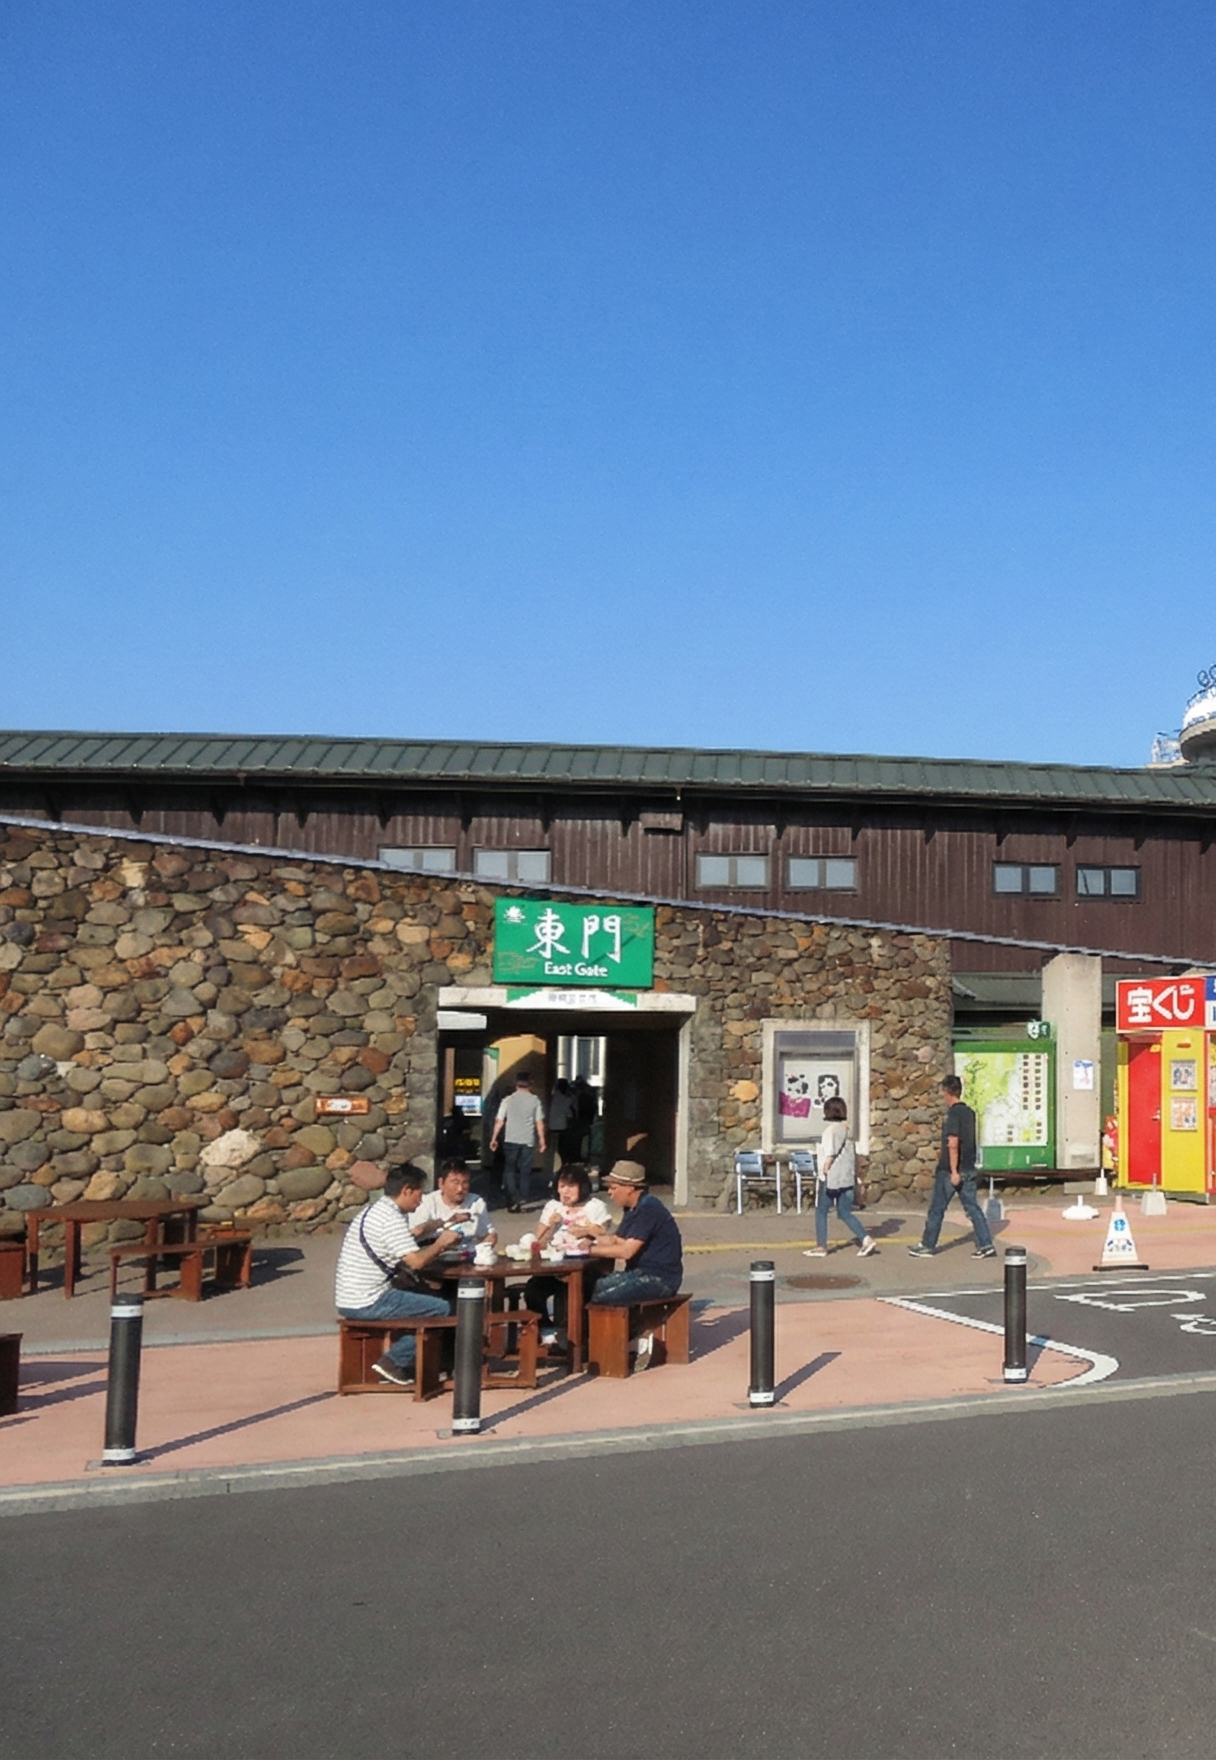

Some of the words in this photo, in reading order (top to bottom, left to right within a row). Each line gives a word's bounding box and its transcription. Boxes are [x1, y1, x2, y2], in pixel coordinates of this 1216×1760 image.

[525, 907, 622, 964] 東門
[544, 961, 572, 976] East
[574, 962, 609, 978] Gate
[1127, 984, 1196, 1023] 宝くじ
